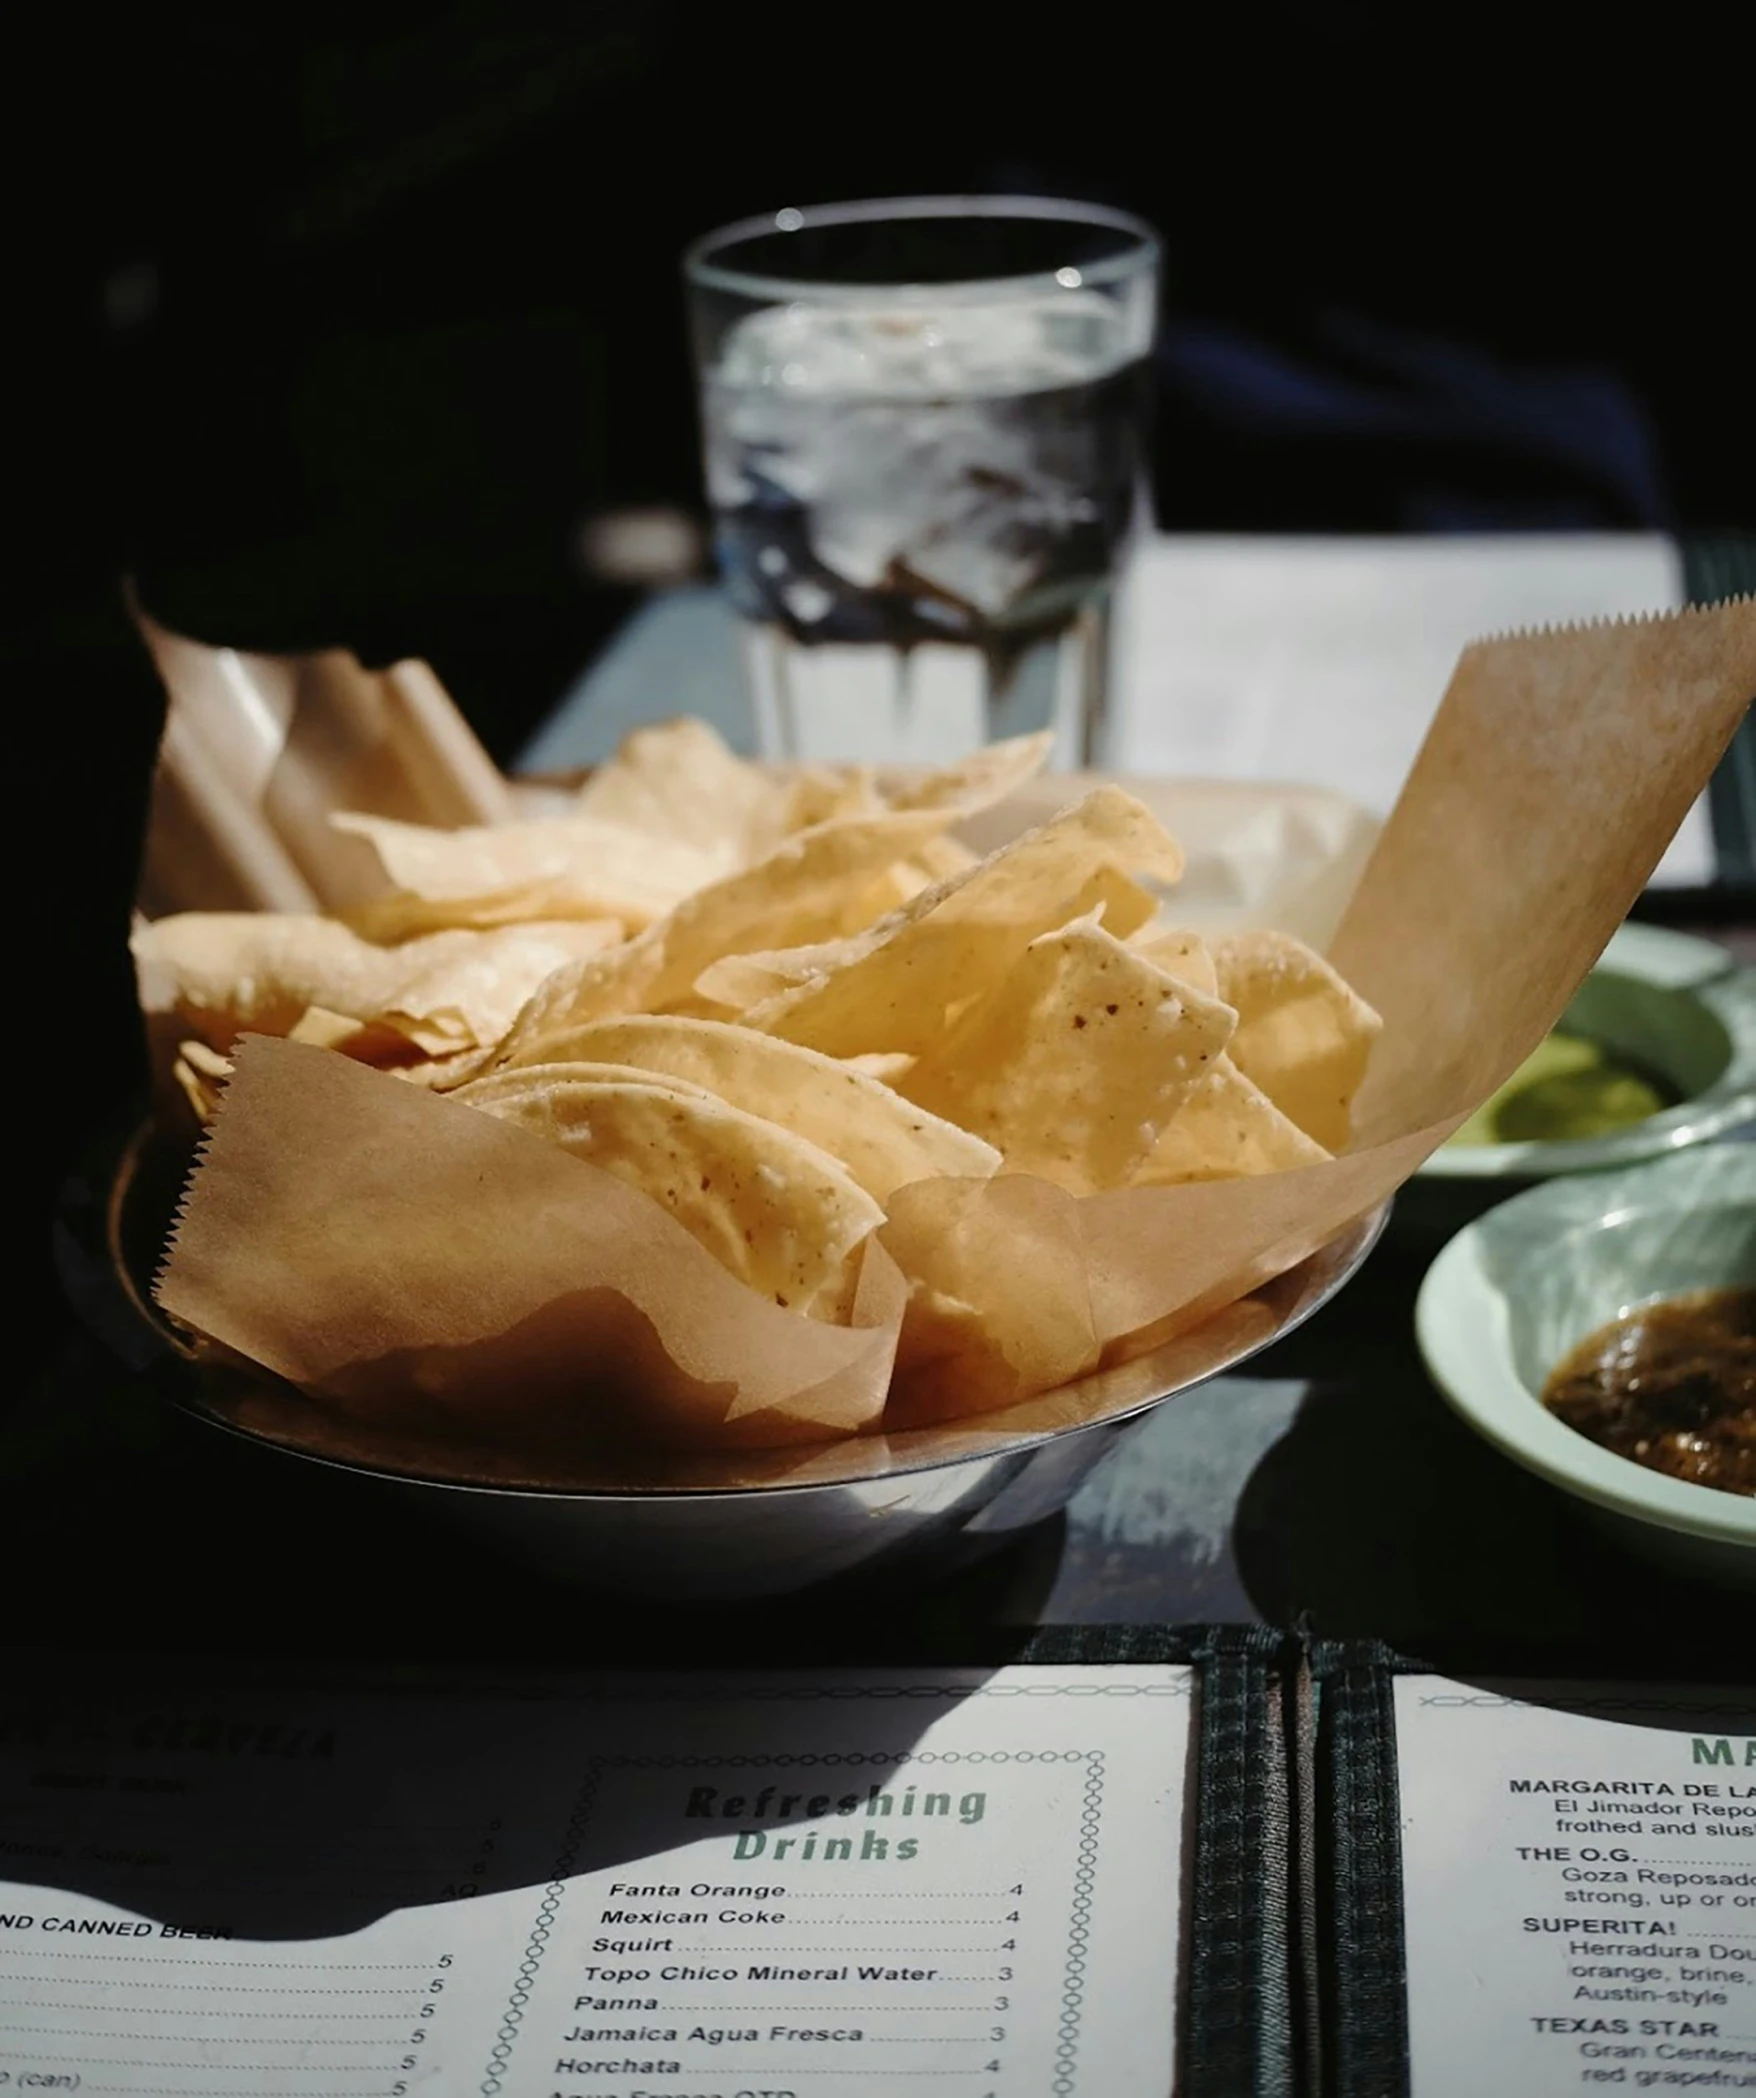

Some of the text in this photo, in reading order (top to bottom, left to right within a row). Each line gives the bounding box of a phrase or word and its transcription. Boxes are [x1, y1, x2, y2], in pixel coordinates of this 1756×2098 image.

[1510, 1780, 1756, 1798] MARGARITA DE LA
[685, 1785, 988, 1824] Refreshing
[1555, 1799, 1578, 1812] El
[1587, 1800, 1683, 1815] Jimador
[1556, 1819, 1756, 1837] frothed and slus
[734, 1830, 920, 1861] Drinks
[1516, 1848, 1638, 1862] THE O.G.
[1562, 1867, 1628, 1883] Goza
[610, 1884, 1022, 1900] Fanta Orange 4
[1565, 1889, 1650, 1908] strong,
[1660, 1894, 1691, 1908] up
[1700, 1895, 1724, 1906] or
[601, 1910, 1019, 1924] Mexican Coke 4
[42, 1918, 152, 1937] CANNED
[159, 1923, 233, 1940] BEER
[1524, 1918, 1675, 1935] SUPERITA!
[593, 1938, 1015, 1954] Squirt 4
[1570, 1941, 1700, 1958] Herradura
[438, 1955, 453, 1968] 5
[586, 1967, 1012, 1984] Topo Chico Mineral Water 3
[1571, 1966, 1752, 1985] orange, brine,
[429, 1979, 444, 1993] 5
[575, 1996, 1009, 2011] Panna 3
[1574, 1986, 1727, 2007] Austin-style
[420, 2004, 435, 2018] 5
[1531, 2018, 1718, 2037] TEXAS STAR
[410, 2029, 425, 2044] 5
[564, 2027, 1005, 2045] Jamaica Agua Fresca 3
[1580, 2042, 1646, 2058] Gran
[401, 2055, 416, 2070] 5
[555, 2059, 1000, 2074] Horchata 4
[1582, 2067, 1626, 2082] red
[17, 2074, 80, 2090] (can)
[392, 2081, 407, 2096] 5
